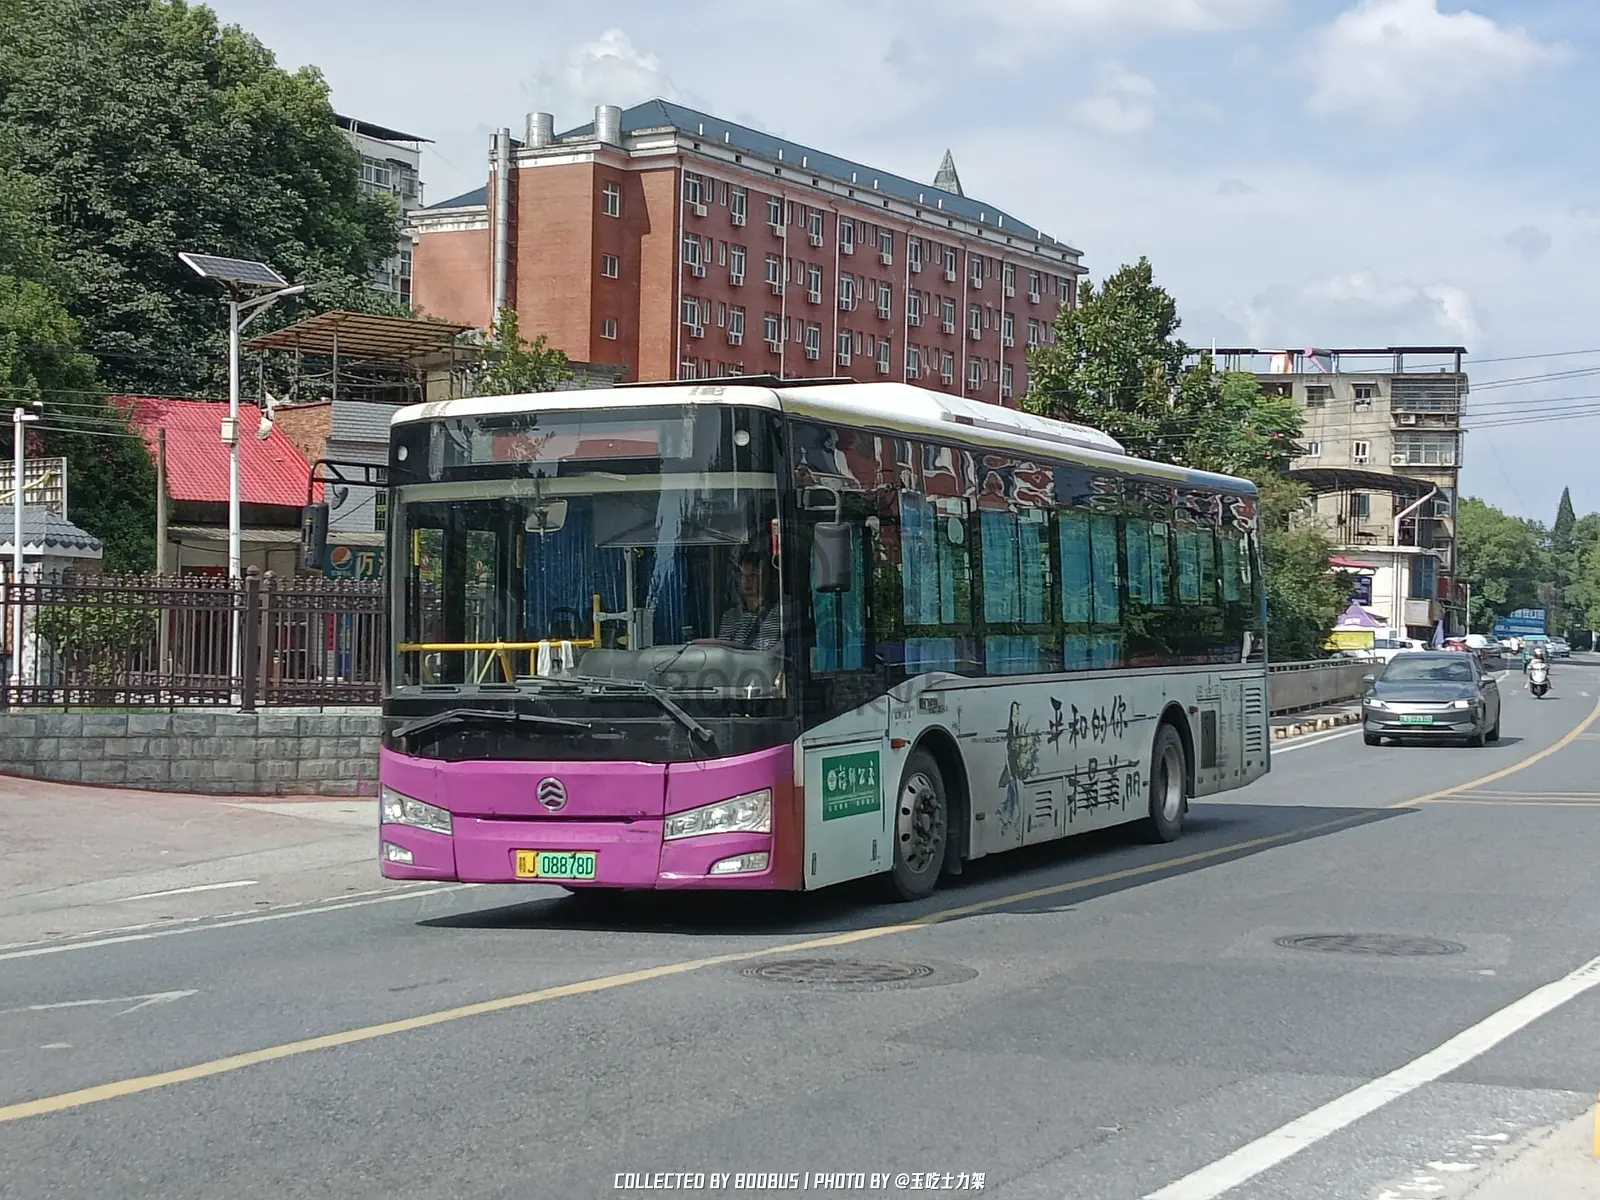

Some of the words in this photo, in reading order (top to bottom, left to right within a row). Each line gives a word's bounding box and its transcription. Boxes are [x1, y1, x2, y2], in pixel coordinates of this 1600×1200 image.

[1046, 694, 1128, 756] 平和的你
[541, 854, 595, 876] 08878D
